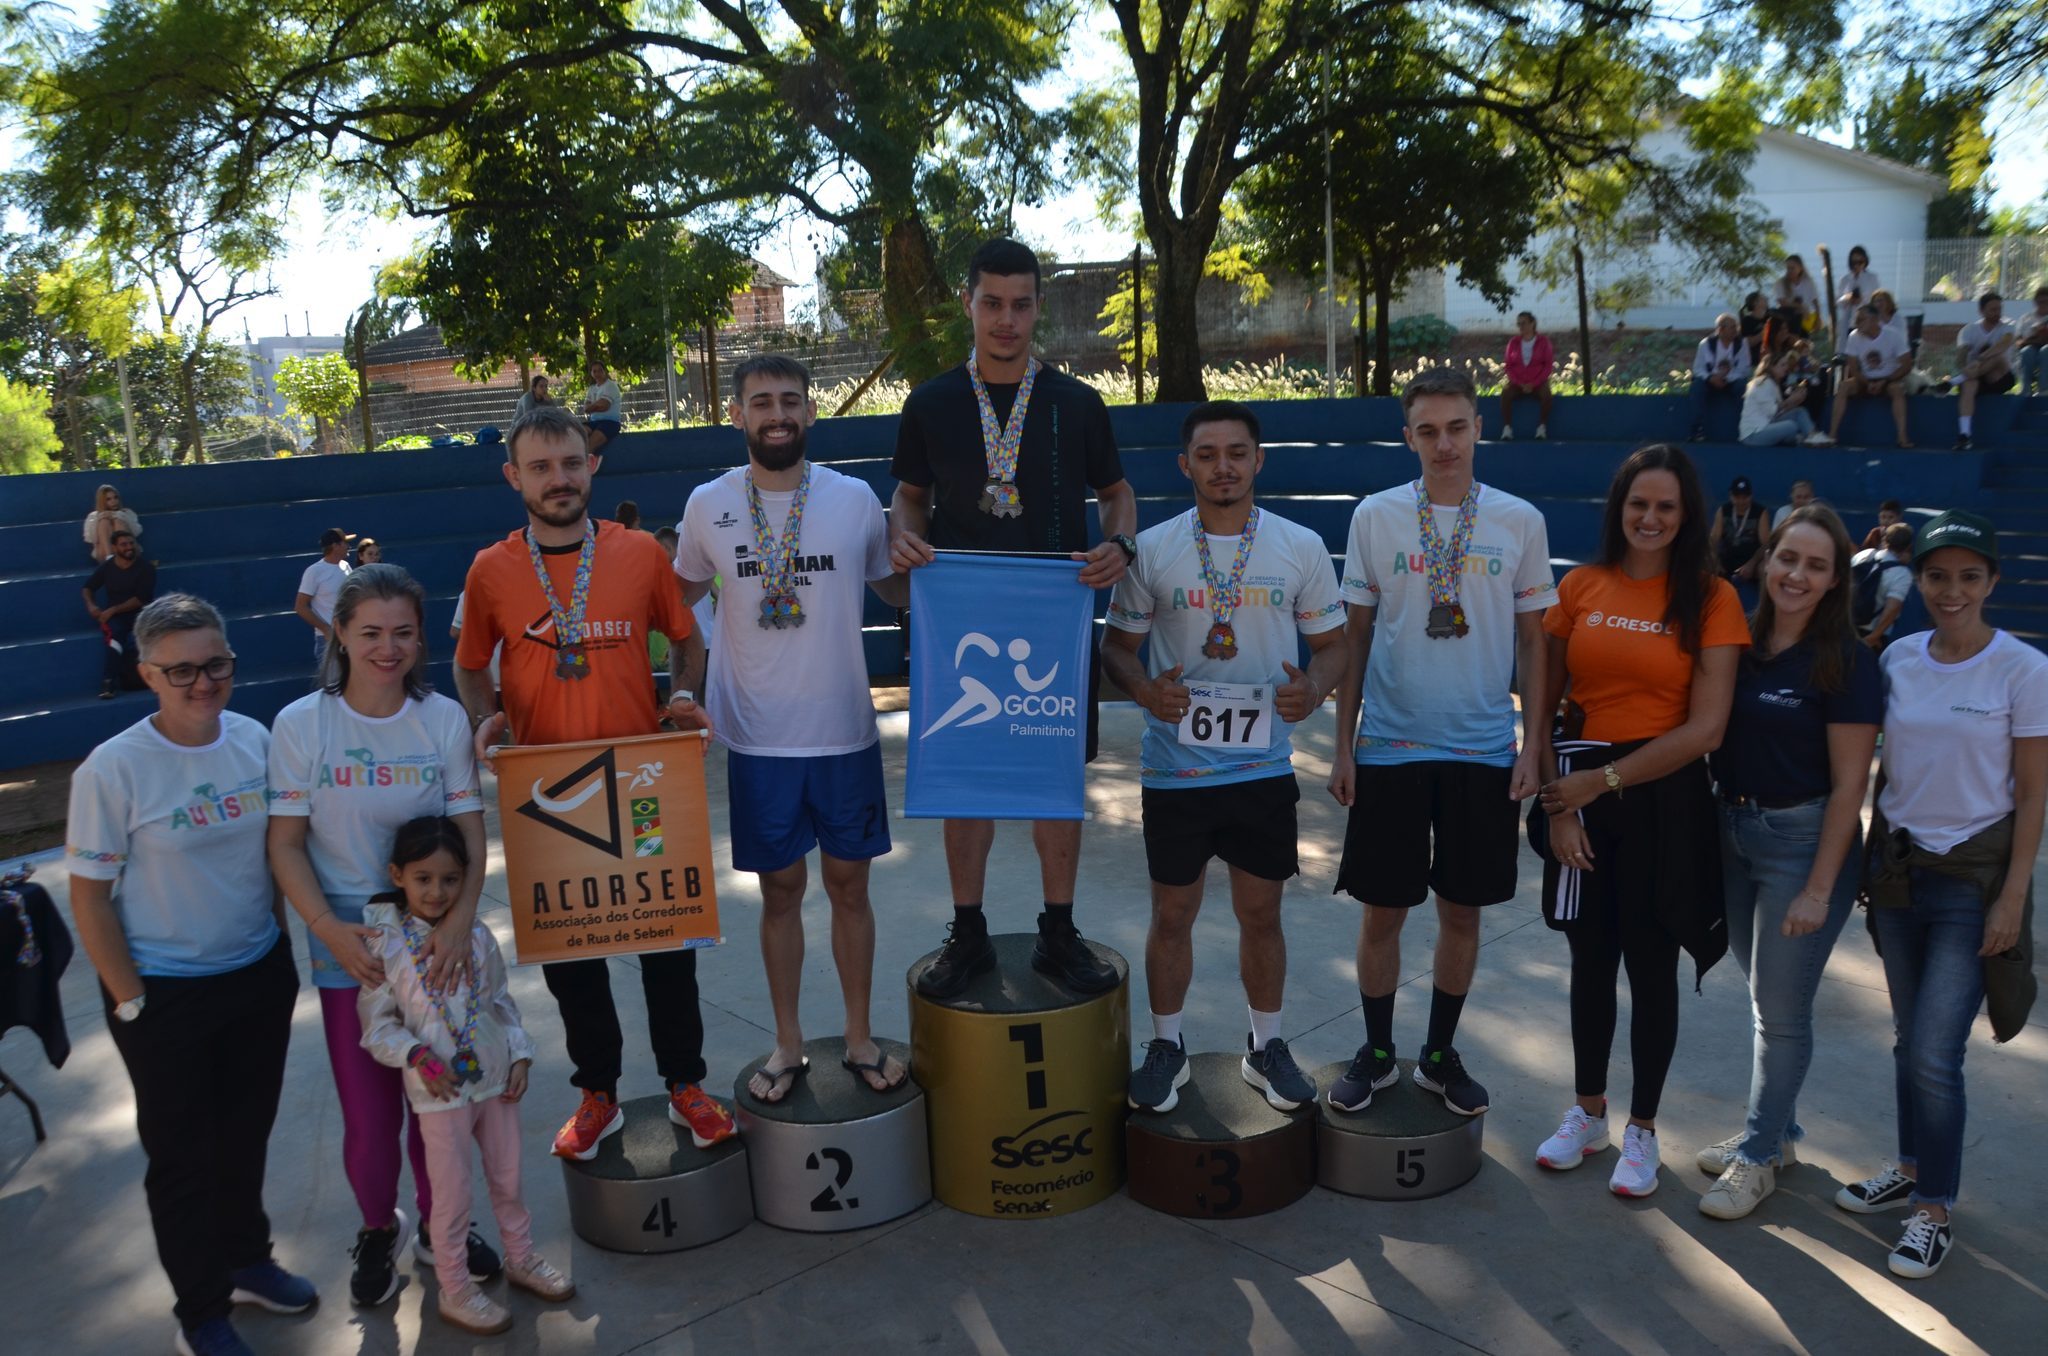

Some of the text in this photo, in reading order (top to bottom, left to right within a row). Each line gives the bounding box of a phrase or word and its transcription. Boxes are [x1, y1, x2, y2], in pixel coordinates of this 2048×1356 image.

[1393, 551, 1502, 576] Aumo
[582, 621, 632, 638] ORSEB
[1003, 695, 1076, 717] GCOR
[1010, 723, 1076, 737] Palmitinho
[1191, 706, 1260, 743] 617
[317, 763, 437, 789] Autismo
[533, 866, 701, 914] ACORSEB
[533, 904, 704, 930] Associação dos Corredores
[566, 925, 674, 947] de Rua de Seberi
[1008, 1022, 1047, 1110] 1
[991, 1127, 1093, 1169] Sesc
[806, 1147, 859, 1212] 2
[1396, 1148, 1426, 1189] 5
[991, 1170, 1094, 1195] Fecomércio
[1195, 1150, 1243, 1216] 3
[642, 1197, 678, 1237] 4
[993, 1198, 1052, 1214] Senac
